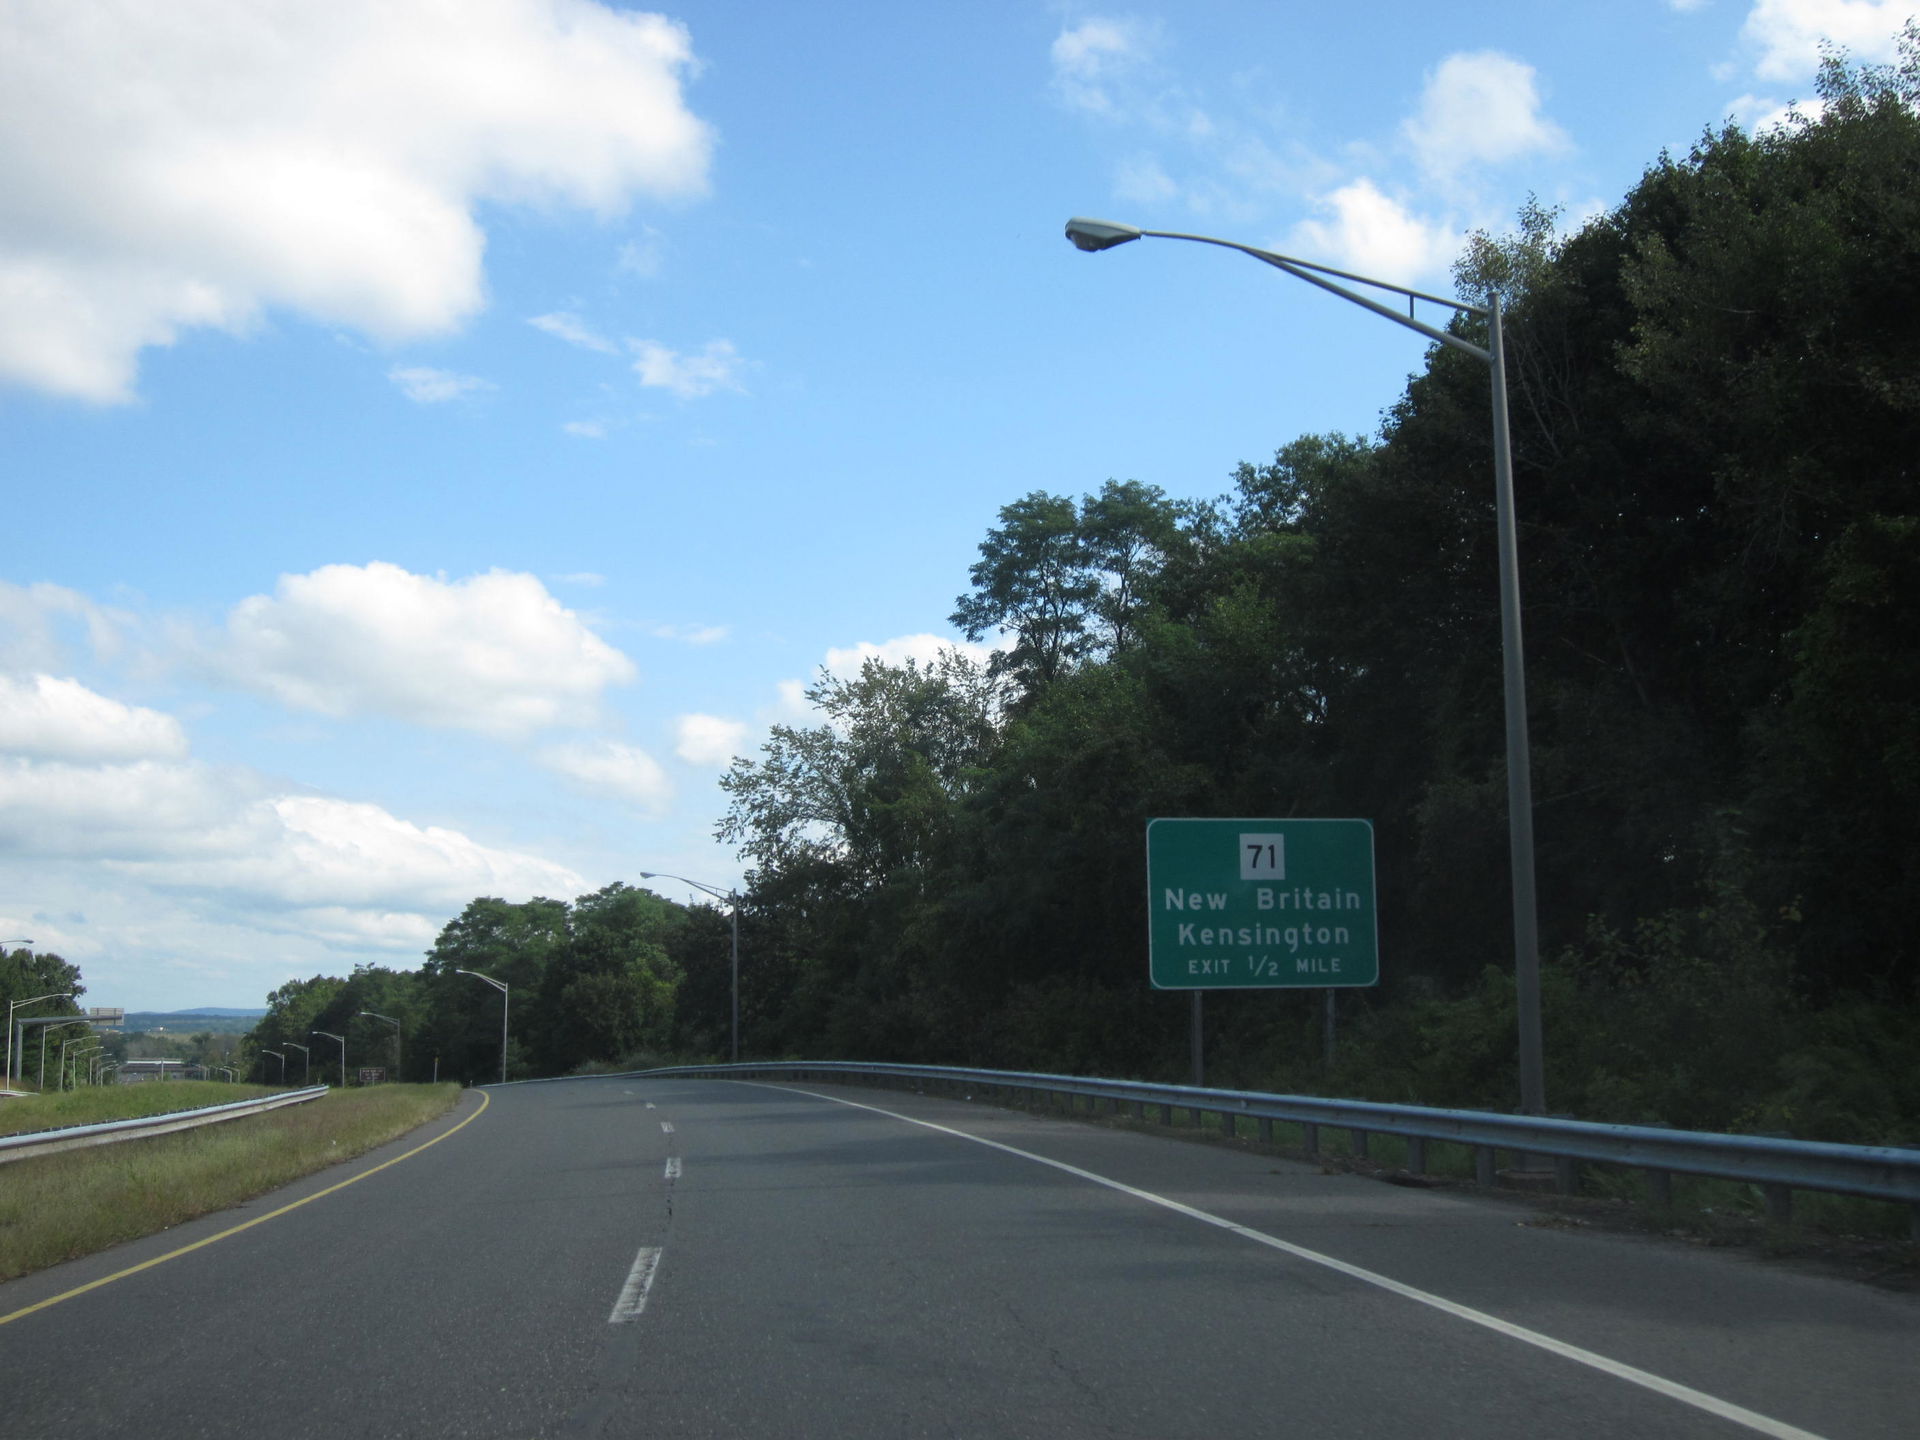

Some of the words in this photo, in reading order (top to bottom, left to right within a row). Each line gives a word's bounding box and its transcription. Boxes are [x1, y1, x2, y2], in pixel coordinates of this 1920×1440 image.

[1247, 844, 1276, 869] 71
[1165, 888, 1228, 911] New
[1257, 887, 1361, 910] Britain
[1178, 923, 1350, 953] Kensington
[1188, 959, 1231, 975] EXIT
[1248, 955, 1279, 976] 1/2
[1296, 958, 1342, 973] MILE
